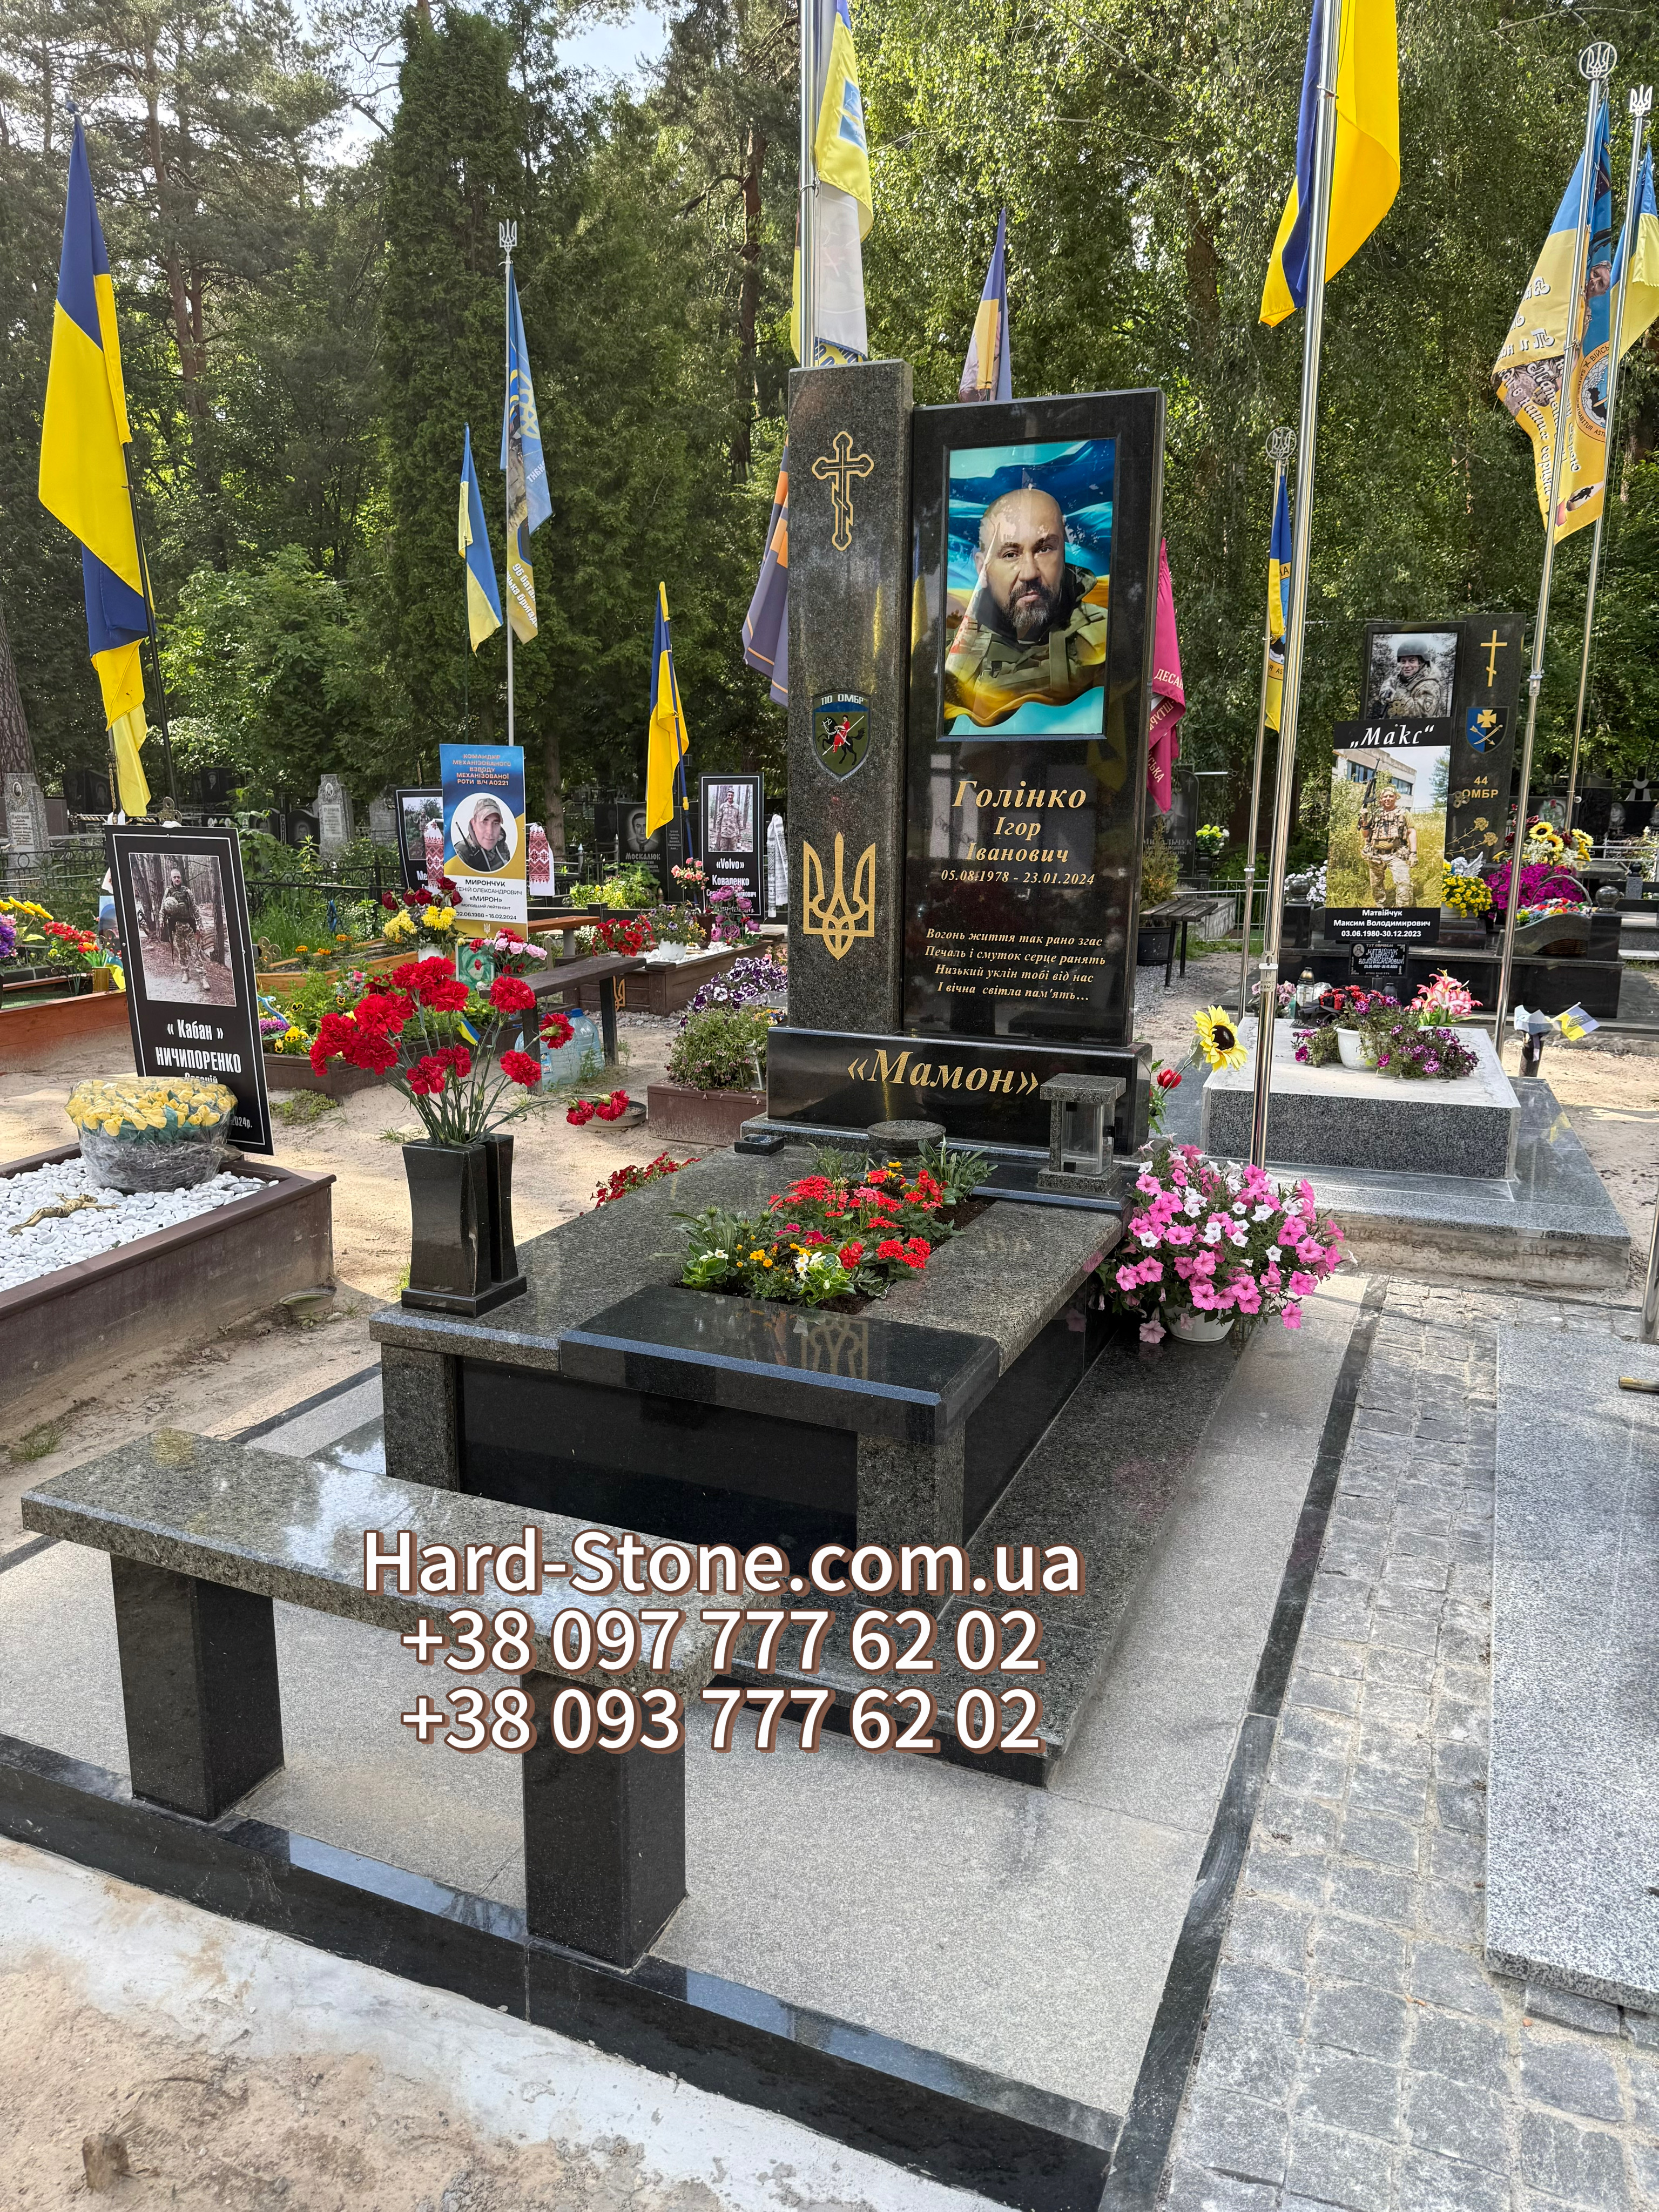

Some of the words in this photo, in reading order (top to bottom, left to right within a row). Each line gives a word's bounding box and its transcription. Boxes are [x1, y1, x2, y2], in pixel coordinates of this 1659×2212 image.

[838, 693, 864, 705] ОМБР
[1473, 776, 1488, 785] 44
[952, 780, 1087, 809] Голінко
[1461, 789, 1499, 799] ОМБР
[993, 816, 1042, 841] Ігор
[965, 842, 1069, 863] Іванович
[716, 858, 745, 869] «Volvo»
[465, 879, 505, 887] МИРОНЧУК
[711, 874, 750, 886] Коваленко
[941, 869, 1010, 883] 05.08.1978
[1022, 872, 1096, 886] 23.01.2024
[473, 887, 522, 895] ОЛЕКСАНДРОВИЧ
[1362, 909, 1403, 918] Матвійчук
[1366, 919, 1431, 928] Володимирович
[926, 928, 966, 940] Вогонь
[968, 933, 1016, 942] життя
[1019, 935, 1043, 944] так
[1044, 936, 1075, 947] рано
[1078, 938, 1103, 946] згас
[925, 946, 966, 958] Печаль
[969, 948, 974, 958] і
[976, 950, 1021, 962] смуток
[1024, 953, 1057, 964] серце
[1058, 955, 1106, 966] ранять
[935, 964, 984, 976] Низький
[986, 968, 1017, 979] уклін
[1021, 970, 1050, 980] тобі
[1052, 970, 1070, 981] від
[1073, 974, 1094, 982] нас
[937, 981, 944, 992] І
[946, 982, 976, 994] вічна
[982, 985, 1022, 997] світла
[177, 1019, 213, 1041] Кабан
[155, 1046, 242, 1074] НИЧИПОРЕНКО
[847, 1049, 1039, 1095] «Мамон»
